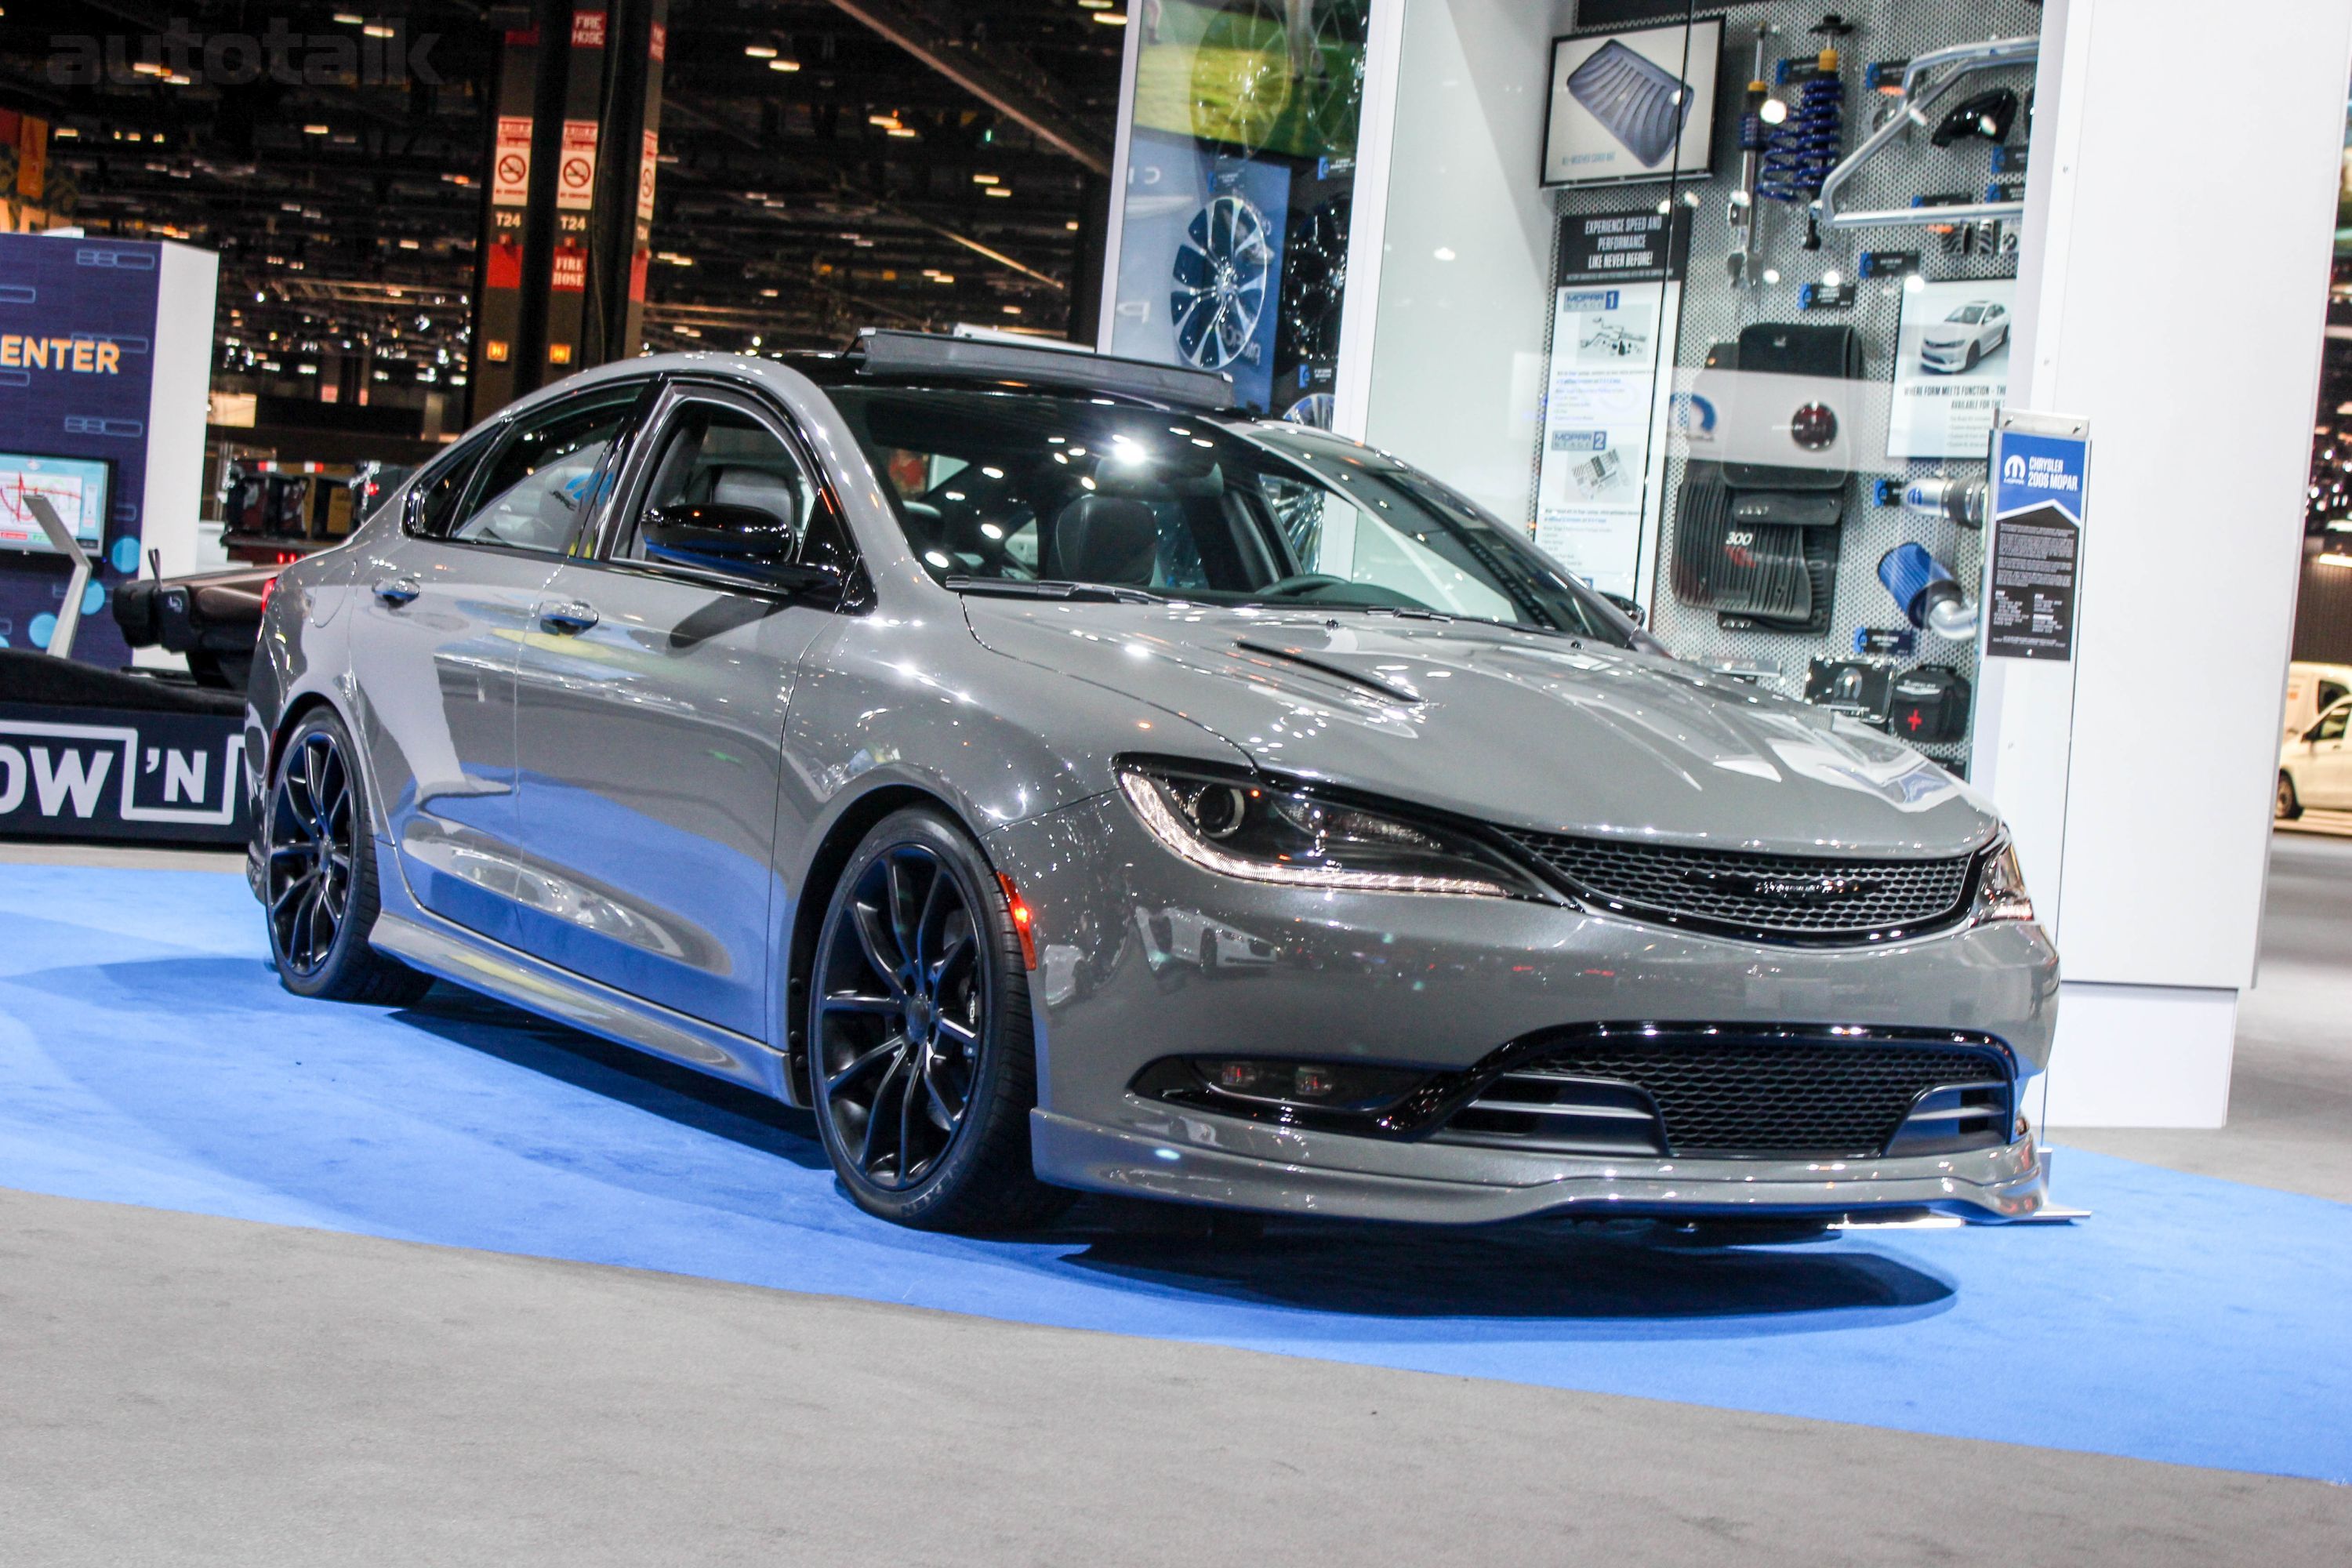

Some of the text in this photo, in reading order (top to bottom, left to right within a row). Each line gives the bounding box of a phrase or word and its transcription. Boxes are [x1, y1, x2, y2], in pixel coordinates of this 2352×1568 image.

[575, 16, 602, 30] FIRE
[572, 31, 604, 45] HOSE
[495, 212, 521, 228] T24
[560, 216, 586, 231] T24
[1584, 216, 1662, 234] EXPERIENCE SPEED AND
[1598, 234, 1646, 251] PERFORMANCE
[556, 256, 584, 271] FIRE
[1588, 251, 1653, 270] LIKE NEVER BEFORE!
[553, 271, 584, 287] HOSE
[0, 334, 121, 375] ENTER
[1924, 385, 1941, 396] FORM
[1941, 385, 1960, 396] MEETS
[1962, 385, 1990, 396] FUNCTION
[2028, 456, 2063, 474] CHRYSLER
[2049, 474, 2078, 492] MOPAR
[1726, 532, 1753, 546] 300
[146, 747, 208, 804] 'N
